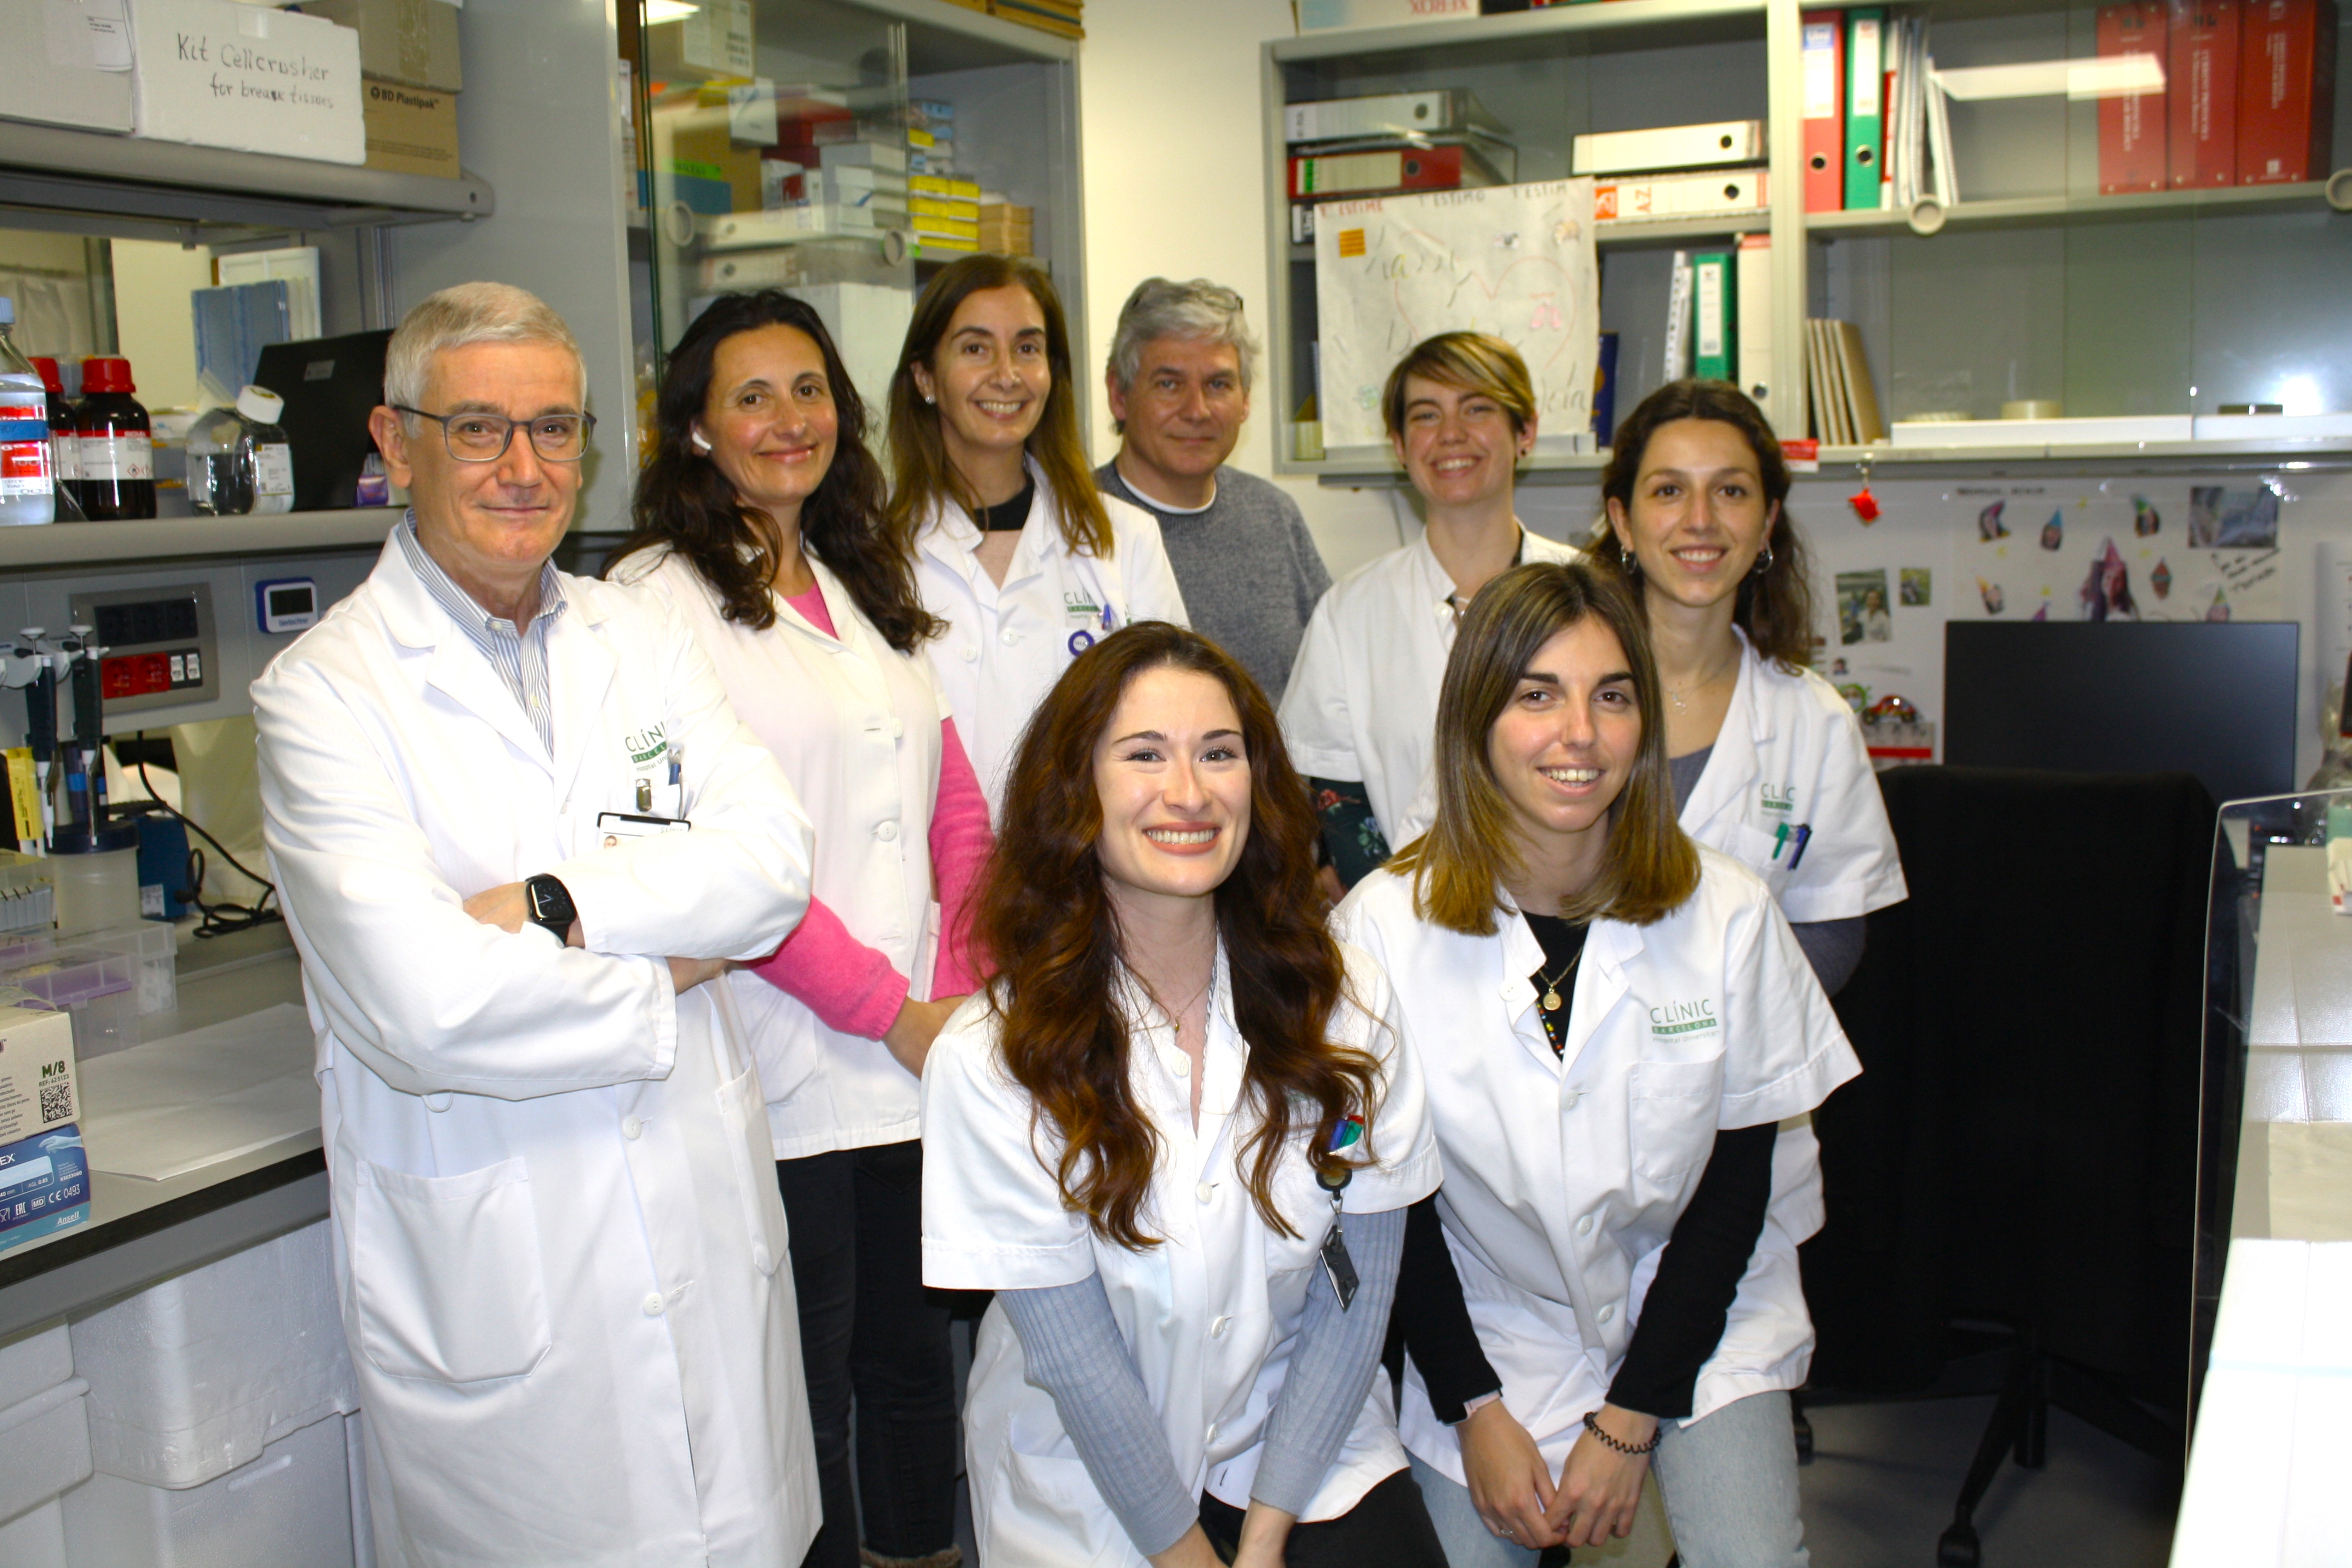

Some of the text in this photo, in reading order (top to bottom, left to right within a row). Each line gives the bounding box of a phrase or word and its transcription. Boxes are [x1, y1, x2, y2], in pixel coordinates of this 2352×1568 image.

[177, 33, 209, 61] Kit
[210, 72, 234, 97] for
[381, 89, 393, 101] BD
[1650, 999, 1714, 1024] CLÍNIC
[42, 1060, 66, 1079] M/8
[64, 1184, 80, 1199] 0493
[33, 1199, 44, 1208] MD
[57, 1211, 80, 1225] Ansell
